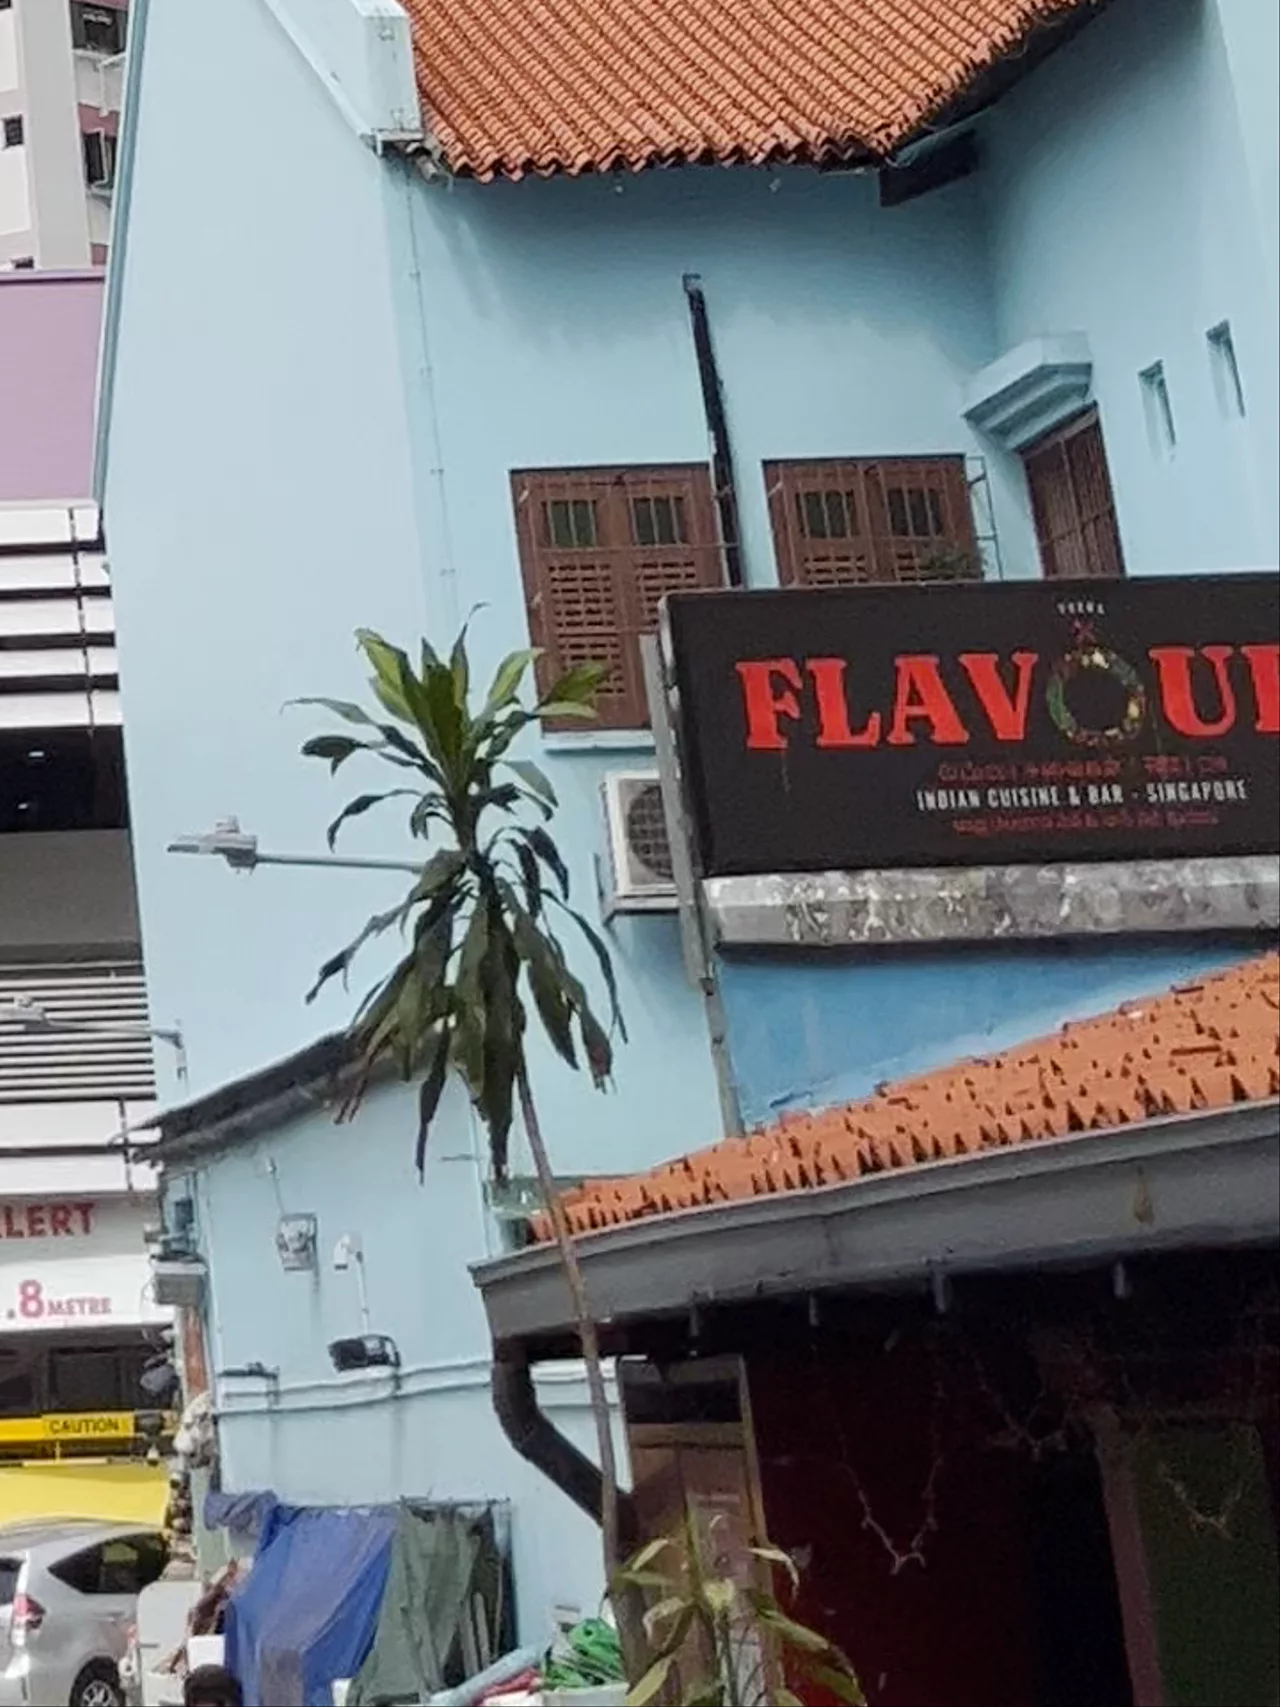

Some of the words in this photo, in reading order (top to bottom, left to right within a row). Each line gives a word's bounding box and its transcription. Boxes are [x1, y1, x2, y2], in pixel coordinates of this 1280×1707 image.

[916, 789, 981, 812] INDIAN
[987, 785, 1060, 809] CUISINE
[1068, 785, 1081, 807] &
[1088, 783, 1124, 805] BAR
[1147, 779, 1248, 804] SINGAPORE
[47, 1298, 112, 1317] METRE
[48, 1418, 121, 1434] CAUTION
